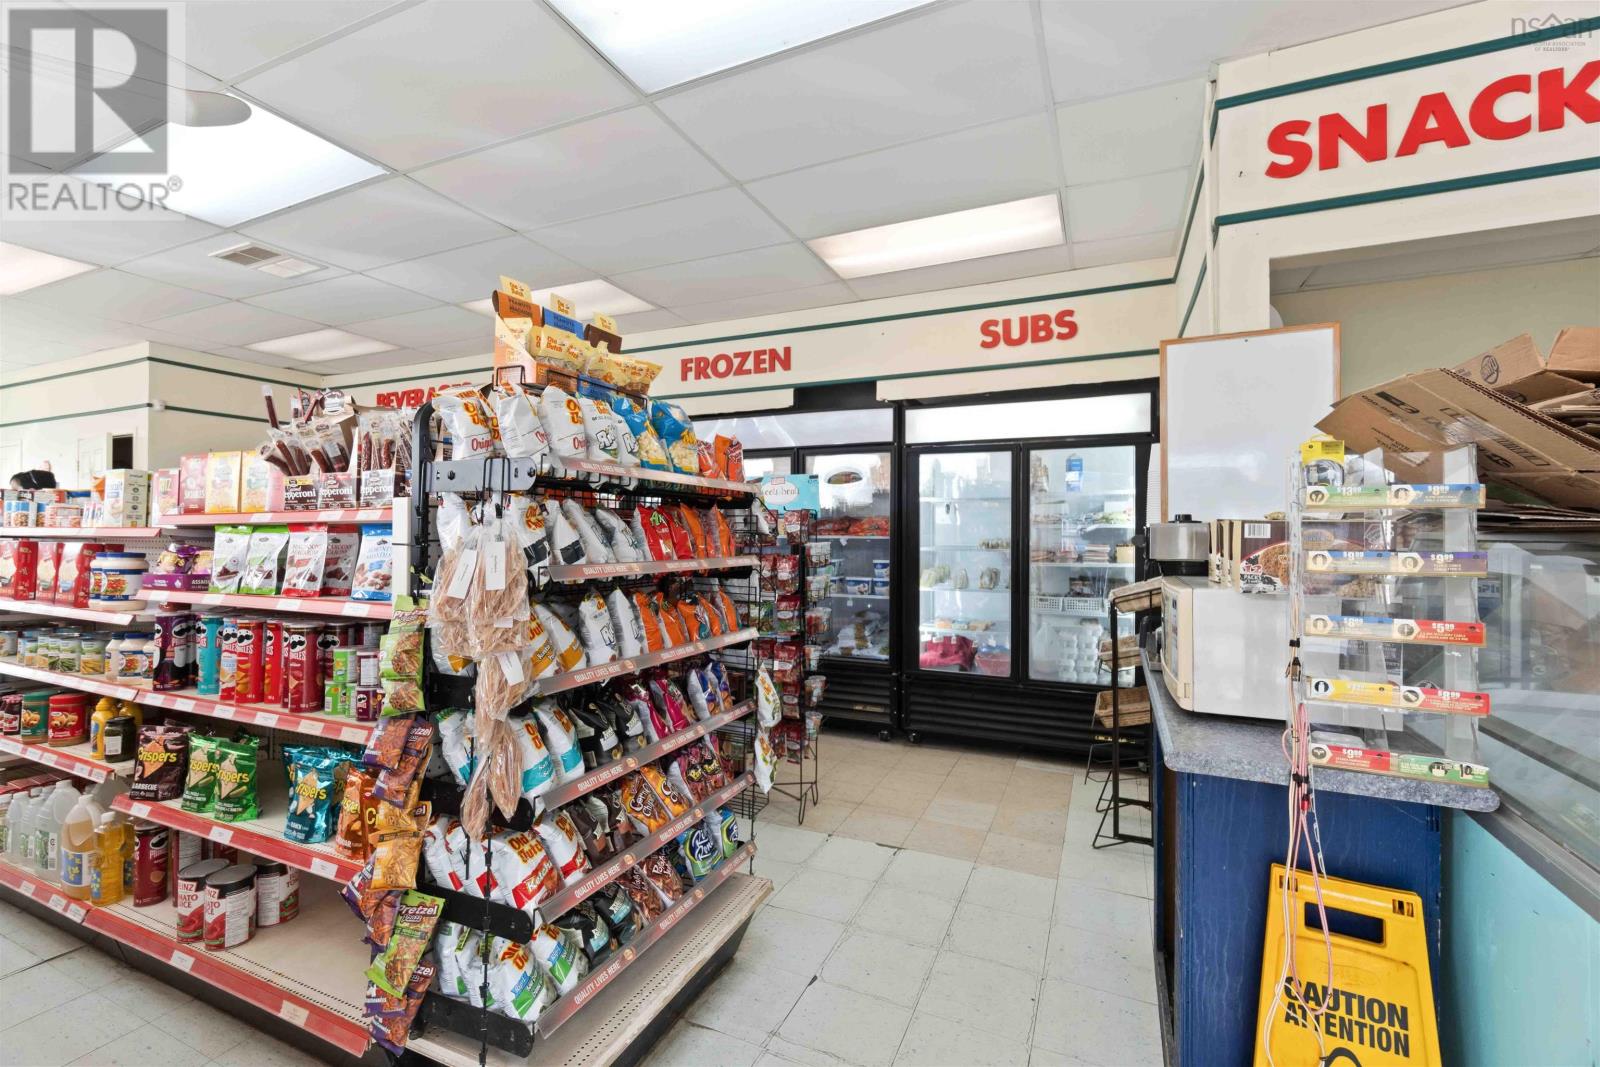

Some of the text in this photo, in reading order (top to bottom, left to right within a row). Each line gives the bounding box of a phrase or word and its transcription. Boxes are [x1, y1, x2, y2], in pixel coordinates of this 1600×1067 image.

[1264, 60, 1600, 180] SNACK
[979, 309, 1079, 349] SUBS
[680, 346, 792, 382] FROZEN
[574, 881, 595, 899] QUALITY
[574, 959, 622, 1005] QUALITY LIVES HERE
[1283, 975, 1409, 1031] CAUTION
[1284, 1002, 1410, 1058] ATTENTION
